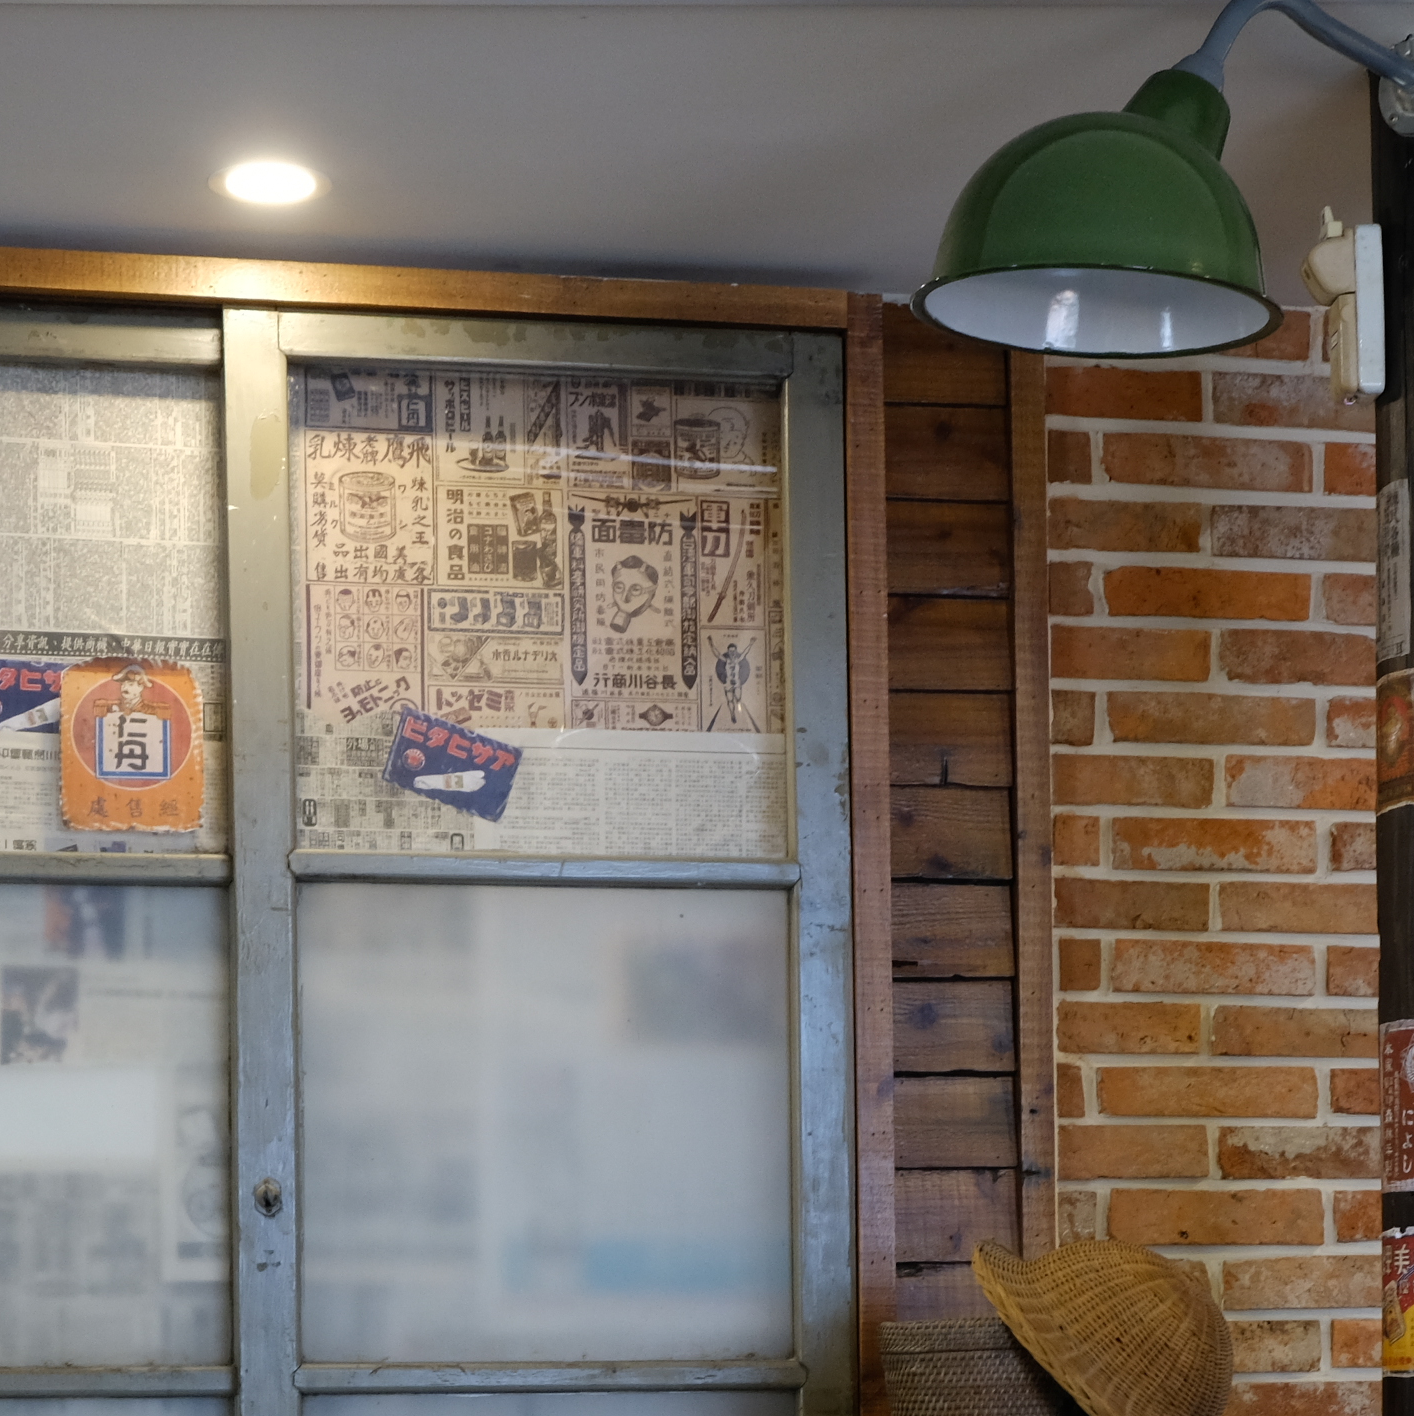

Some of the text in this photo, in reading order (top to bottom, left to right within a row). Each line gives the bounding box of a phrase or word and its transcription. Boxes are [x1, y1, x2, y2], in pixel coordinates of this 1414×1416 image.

[446, 488, 466, 581] 明治の食品
[591, 518, 673, 546] 防毒面
[701, 501, 729, 557] 軍刀
[115, 713, 149, 770] 仁丹
[1401, 1109, 1414, 1174] によし
